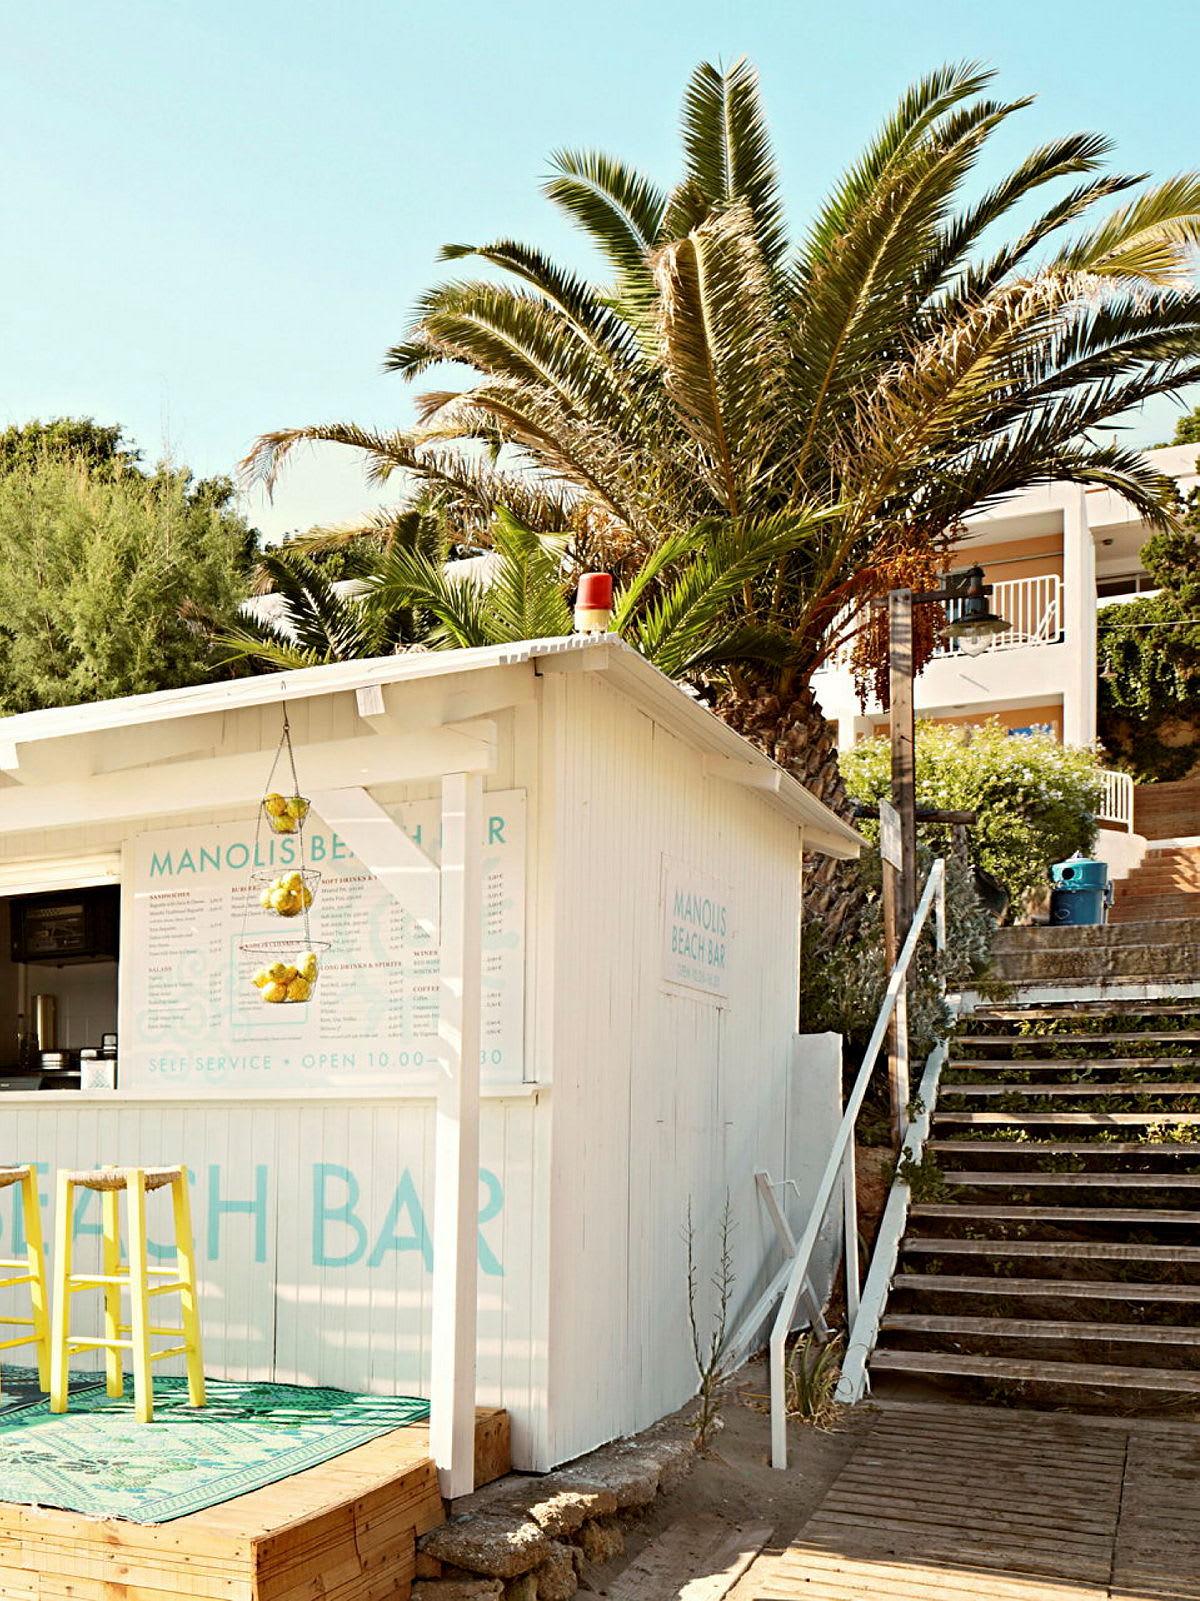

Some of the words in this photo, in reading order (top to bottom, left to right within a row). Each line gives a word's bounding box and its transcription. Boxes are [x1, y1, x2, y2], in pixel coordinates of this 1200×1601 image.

[150, 838, 296, 877] MANOLIS
[311, 824, 421, 861] BEH
[673, 888, 727, 936] MANOLIS
[672, 925, 705, 961] BEACH
[708, 940, 725, 968] BAR
[195, 1056, 271, 1071] SERVICE
[302, 1053, 356, 1069] OPEN
[311, 1163, 505, 1277] BAR
